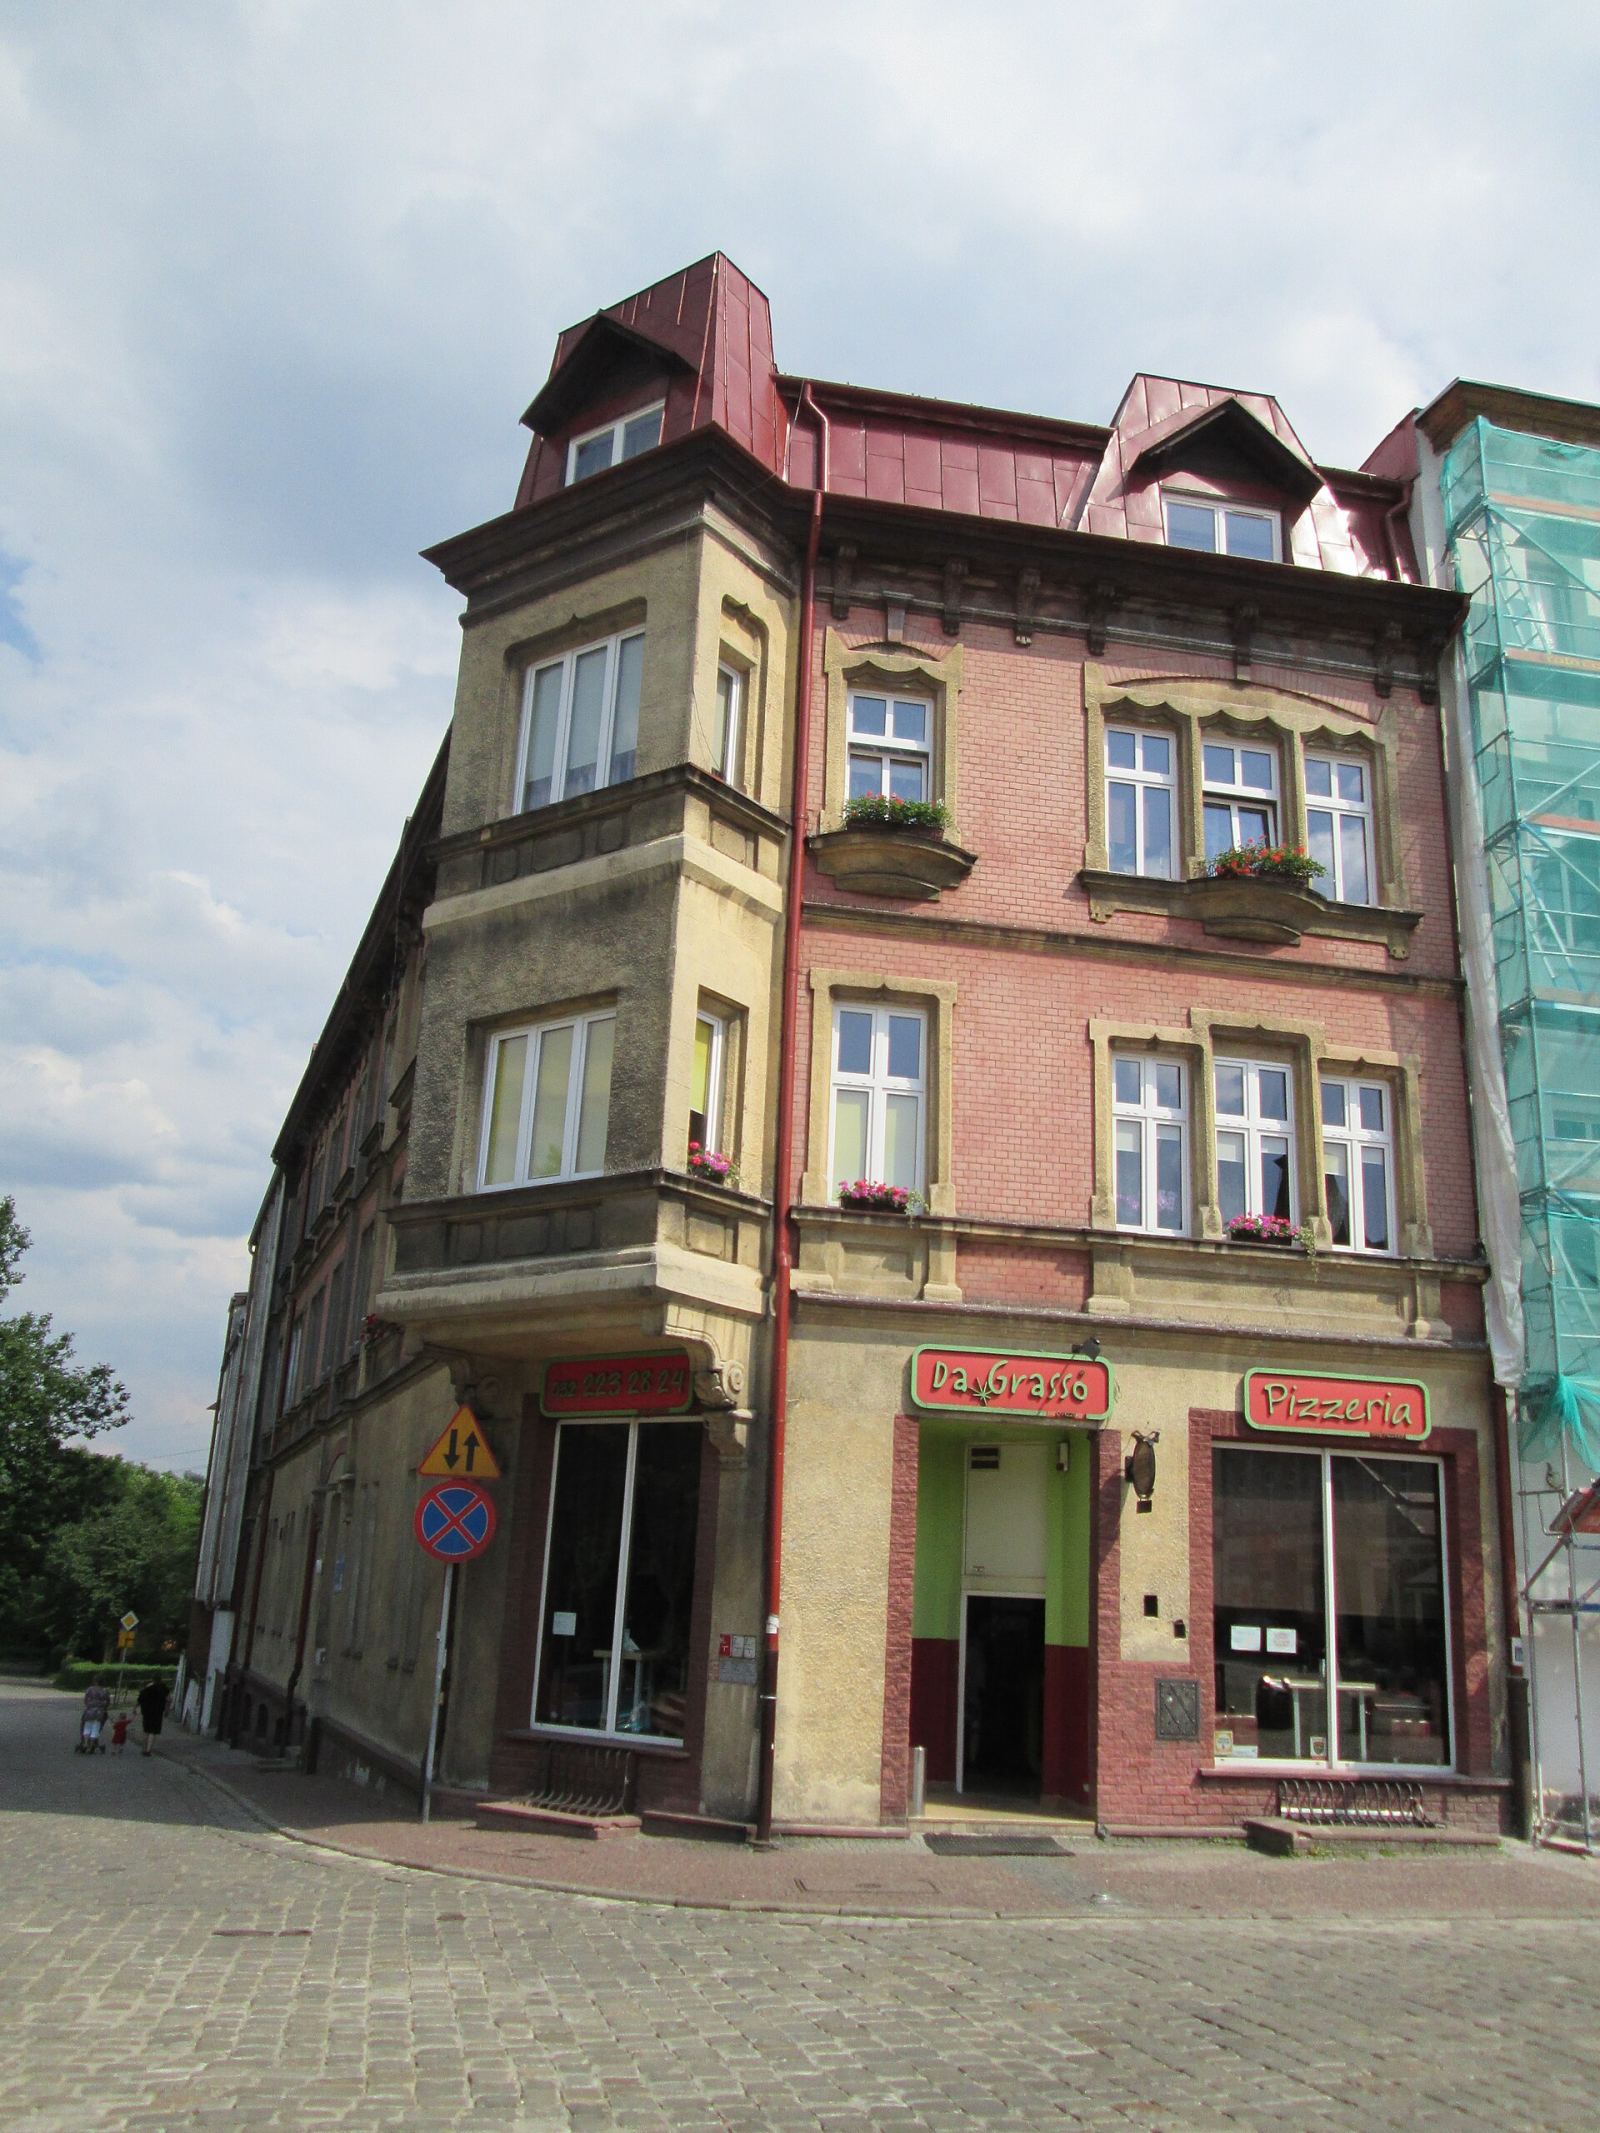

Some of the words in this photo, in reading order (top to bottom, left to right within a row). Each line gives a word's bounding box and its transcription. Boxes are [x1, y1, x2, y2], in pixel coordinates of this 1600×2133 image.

[583, 1372, 622, 1396] 223
[628, 1369, 652, 1394] 28
[657, 1369, 686, 1393] 24
[932, 1360, 968, 1393] Da
[1264, 1383, 1413, 1425] Pizzeria
